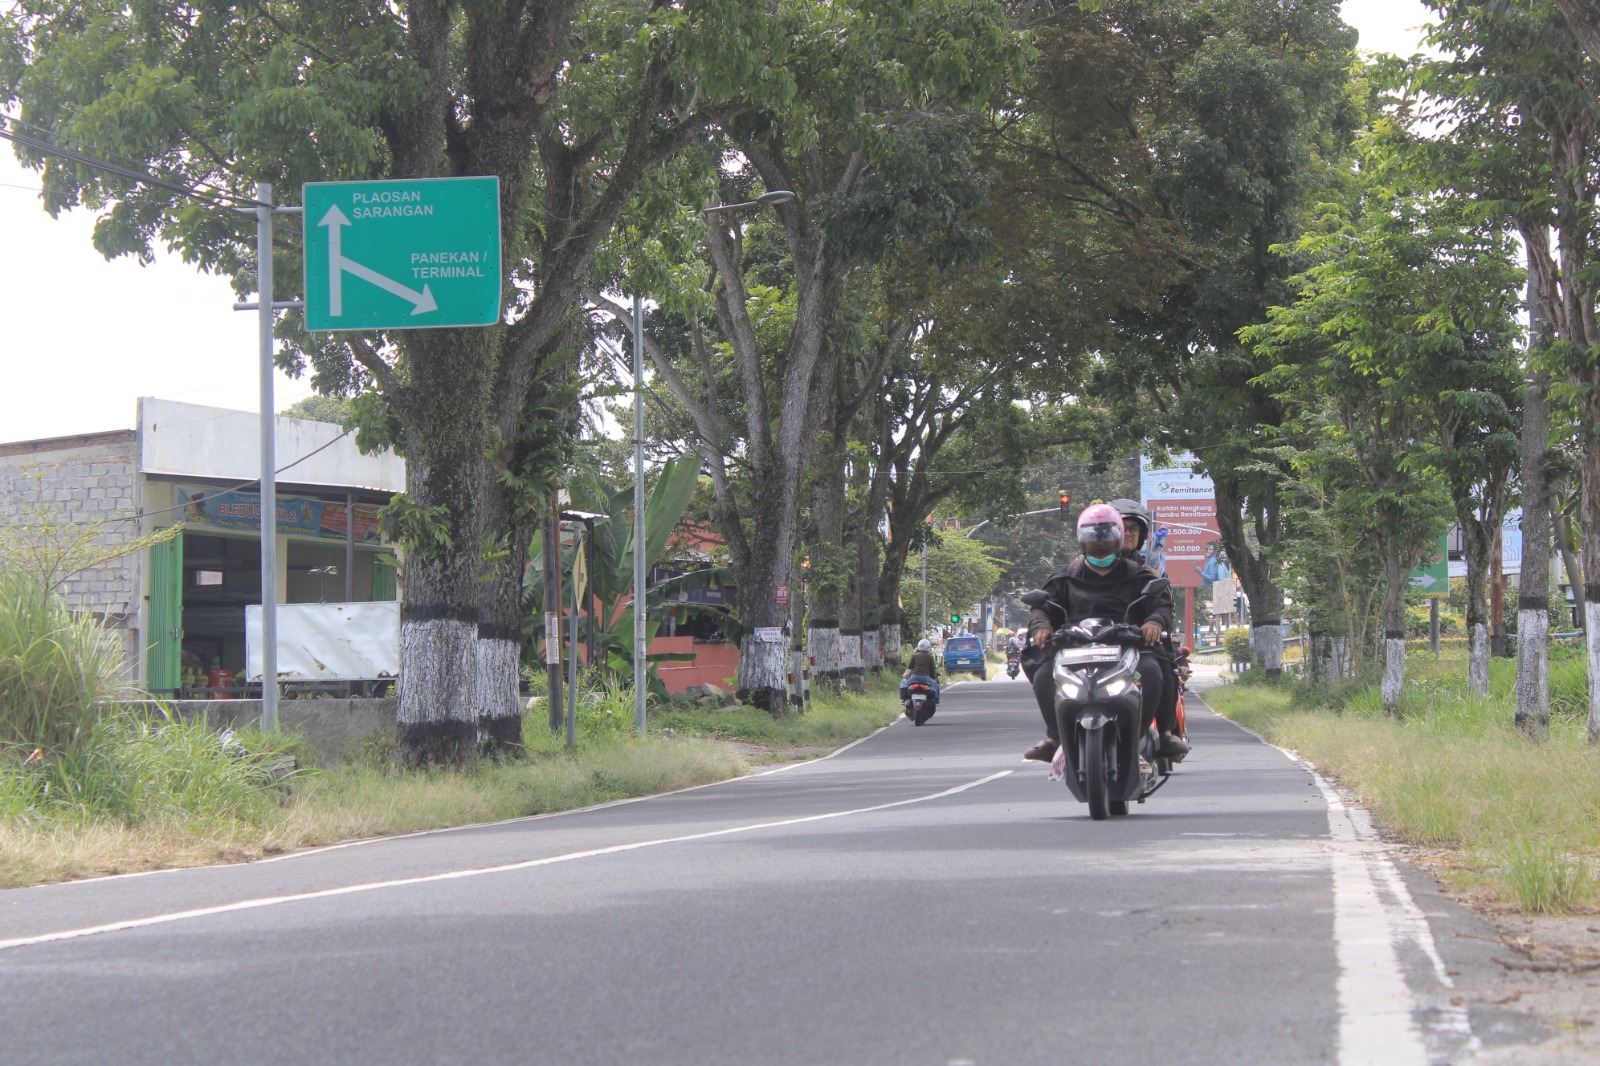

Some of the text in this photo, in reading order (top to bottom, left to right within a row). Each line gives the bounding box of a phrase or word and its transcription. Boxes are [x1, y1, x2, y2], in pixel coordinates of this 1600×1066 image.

[352, 191, 421, 204] PLAOSAN
[353, 205, 434, 219] SARANGAN
[411, 251, 479, 264] PANEKAN
[412, 266, 485, 278] TERMINAL
[1170, 486, 1213, 494] Remittance
